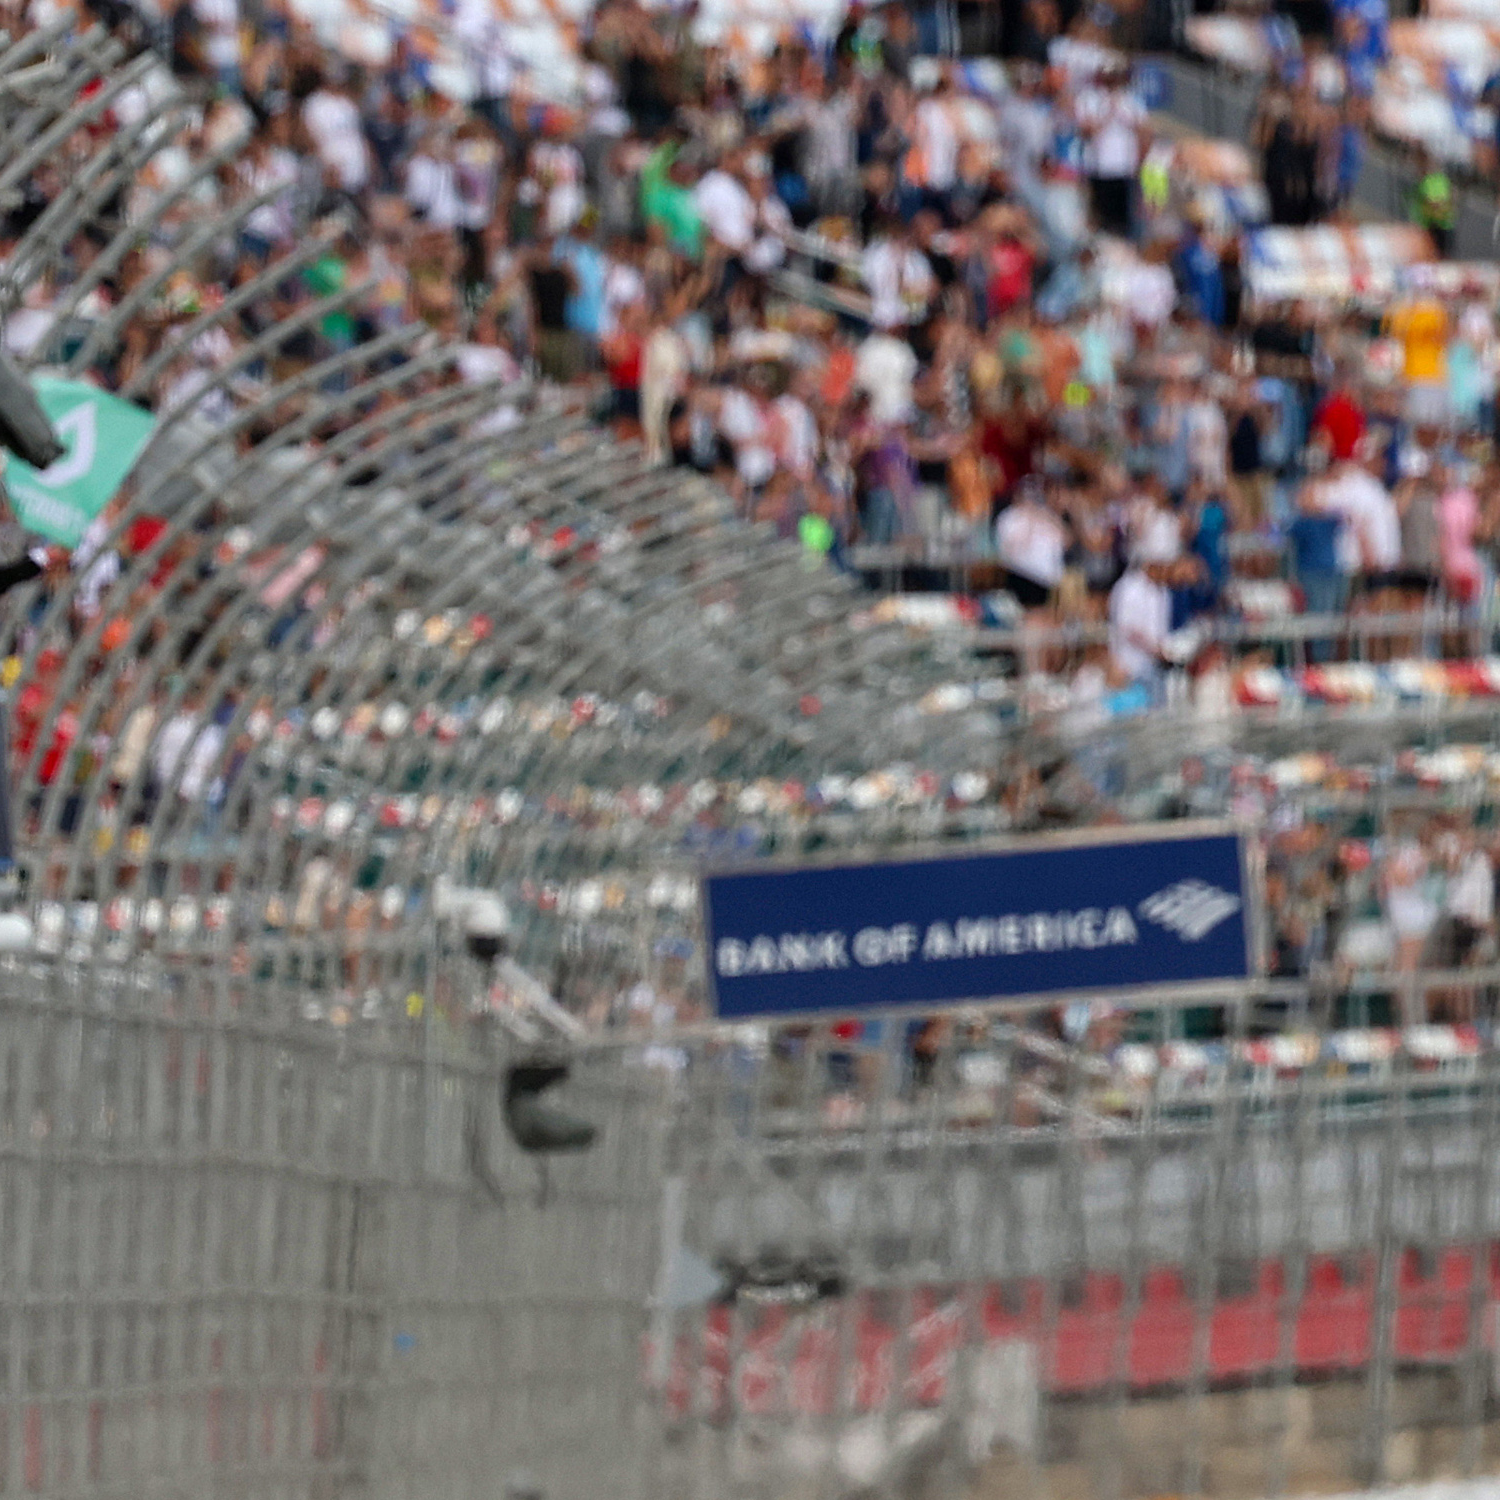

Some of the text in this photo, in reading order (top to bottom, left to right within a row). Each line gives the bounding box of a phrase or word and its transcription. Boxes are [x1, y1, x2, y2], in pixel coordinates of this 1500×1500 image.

[717, 906, 1138, 977] BANK OF AMERICA
